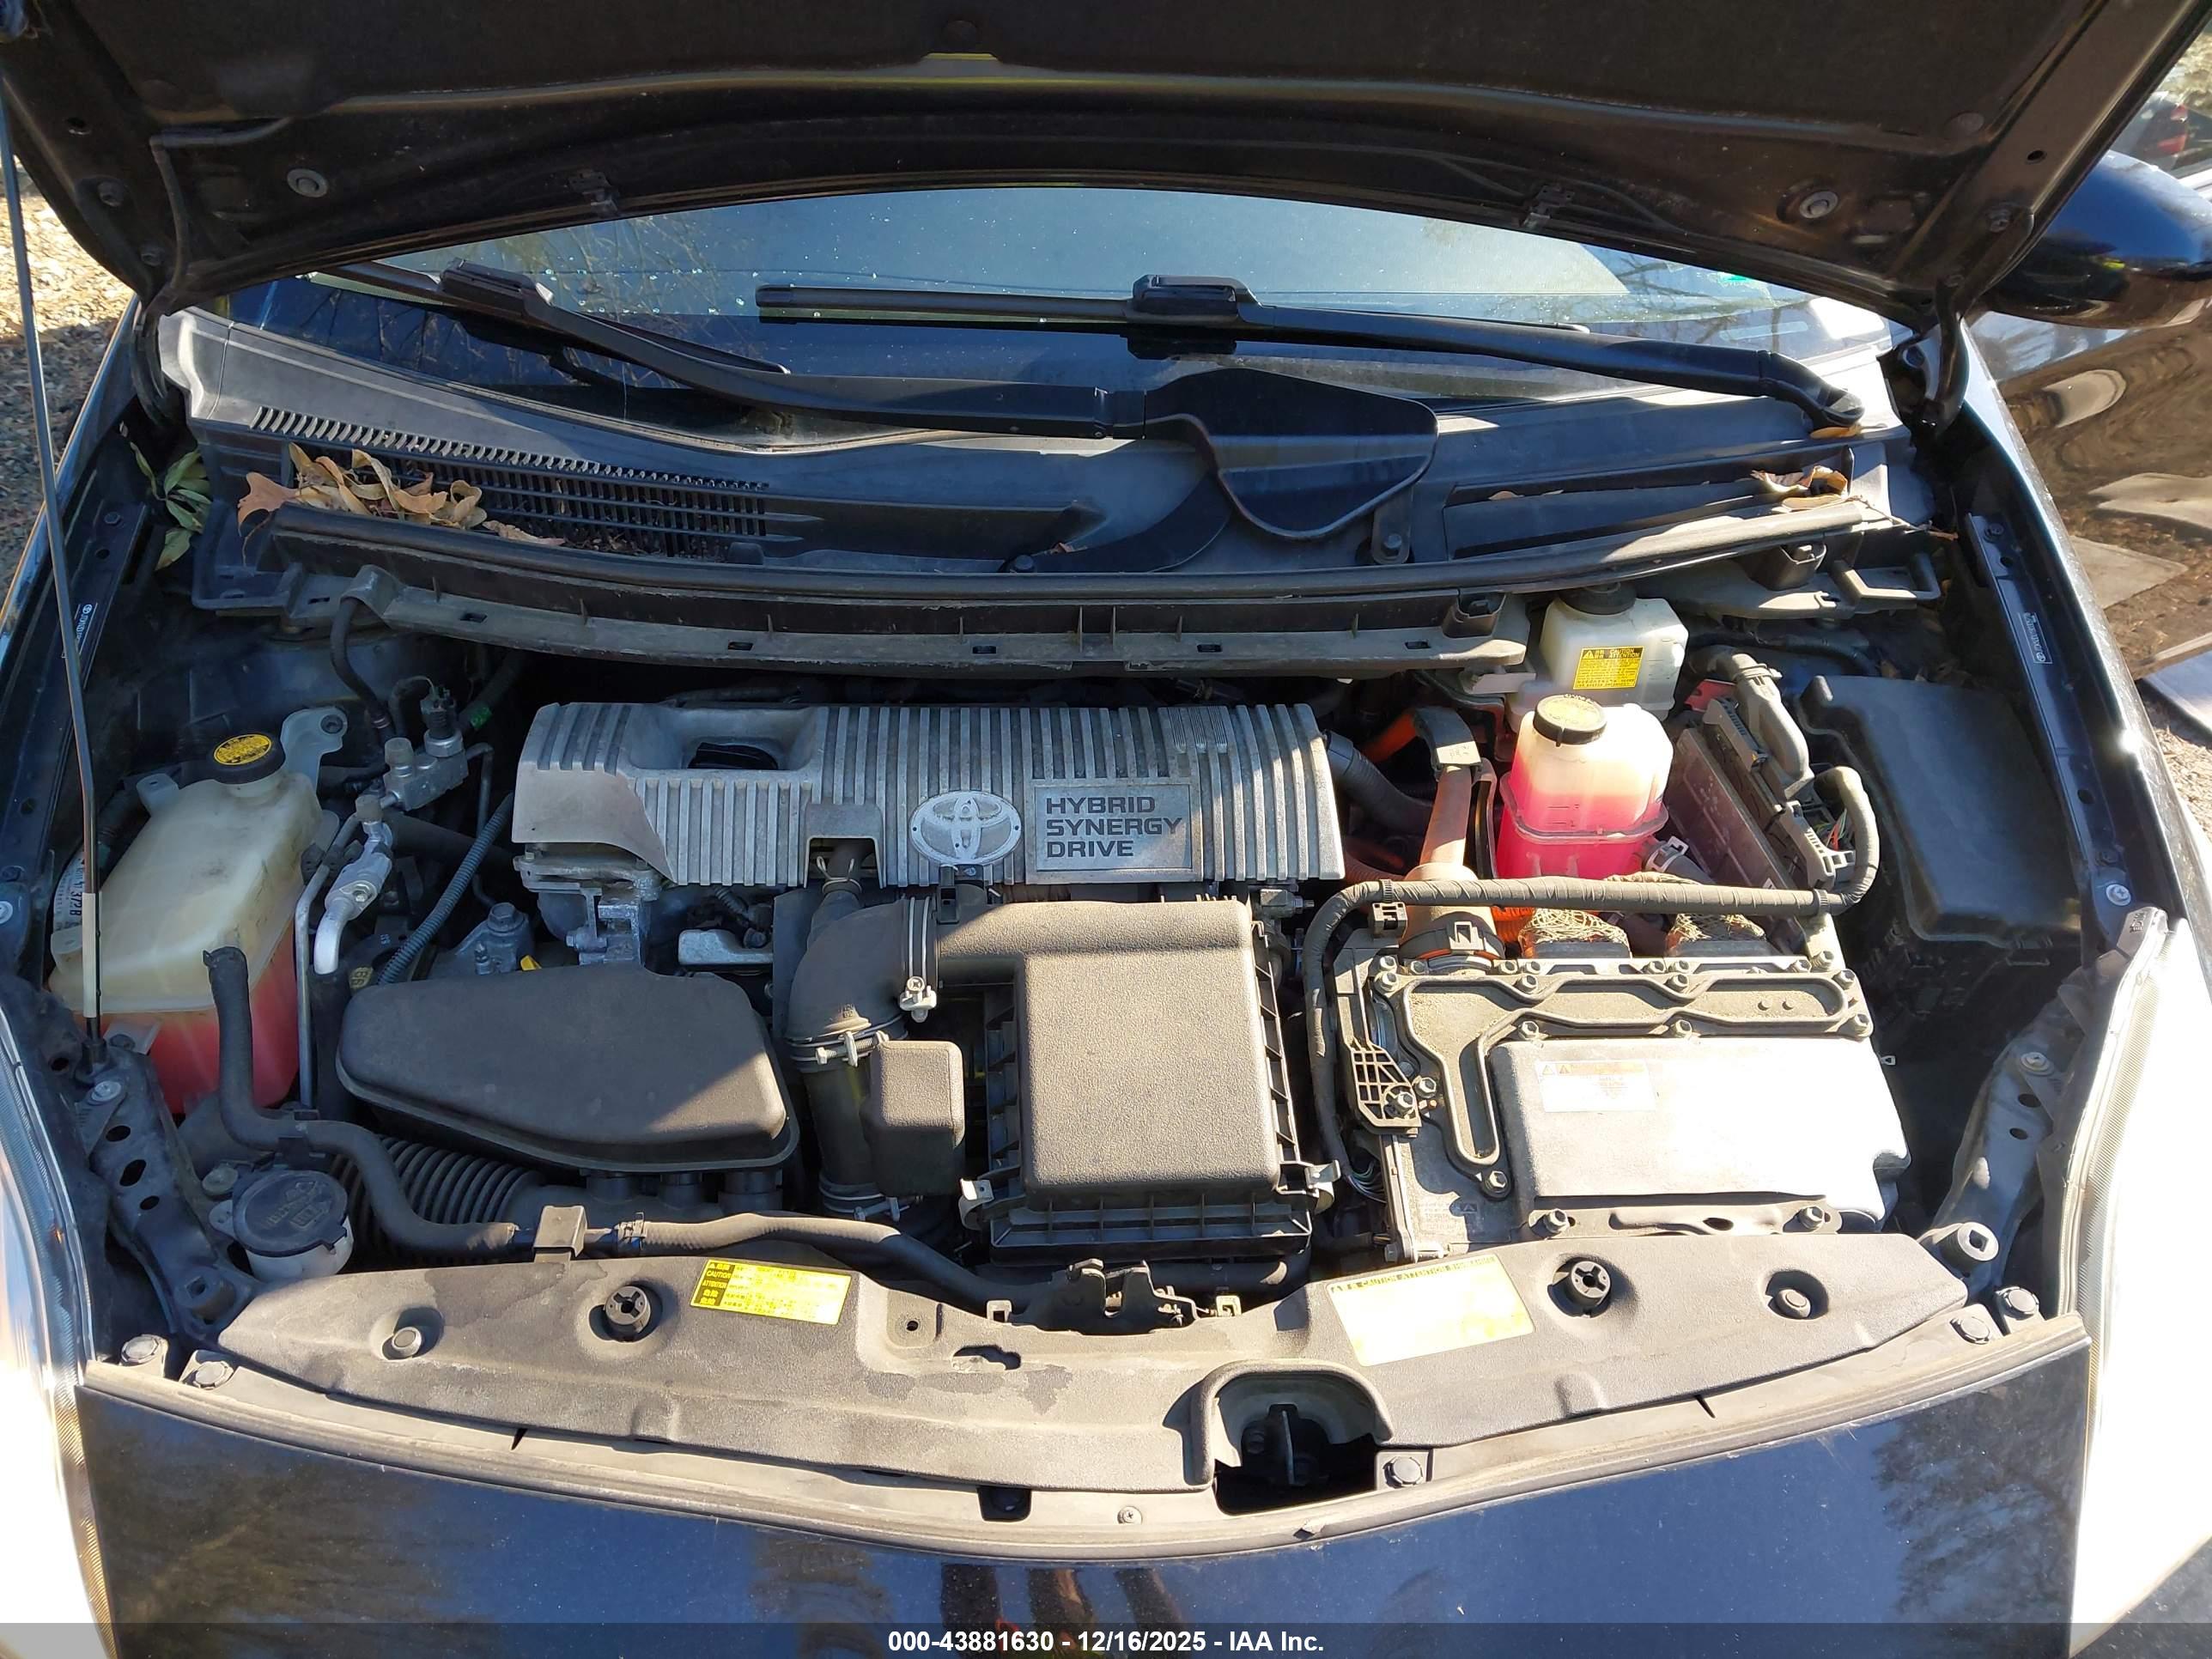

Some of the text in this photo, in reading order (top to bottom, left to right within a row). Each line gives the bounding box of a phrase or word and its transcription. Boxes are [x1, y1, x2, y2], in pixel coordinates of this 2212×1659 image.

[1046, 796, 1156, 815] HYBRID
[1046, 817, 1183, 836] SYNERGY
[1047, 840, 1134, 858] DRIVE
[706, 1270, 732, 1279] CAUTION
[1364, 1266, 1446, 1286] CAUTION ATTENTION
[702, 1280, 728, 1289] ATTENTION
